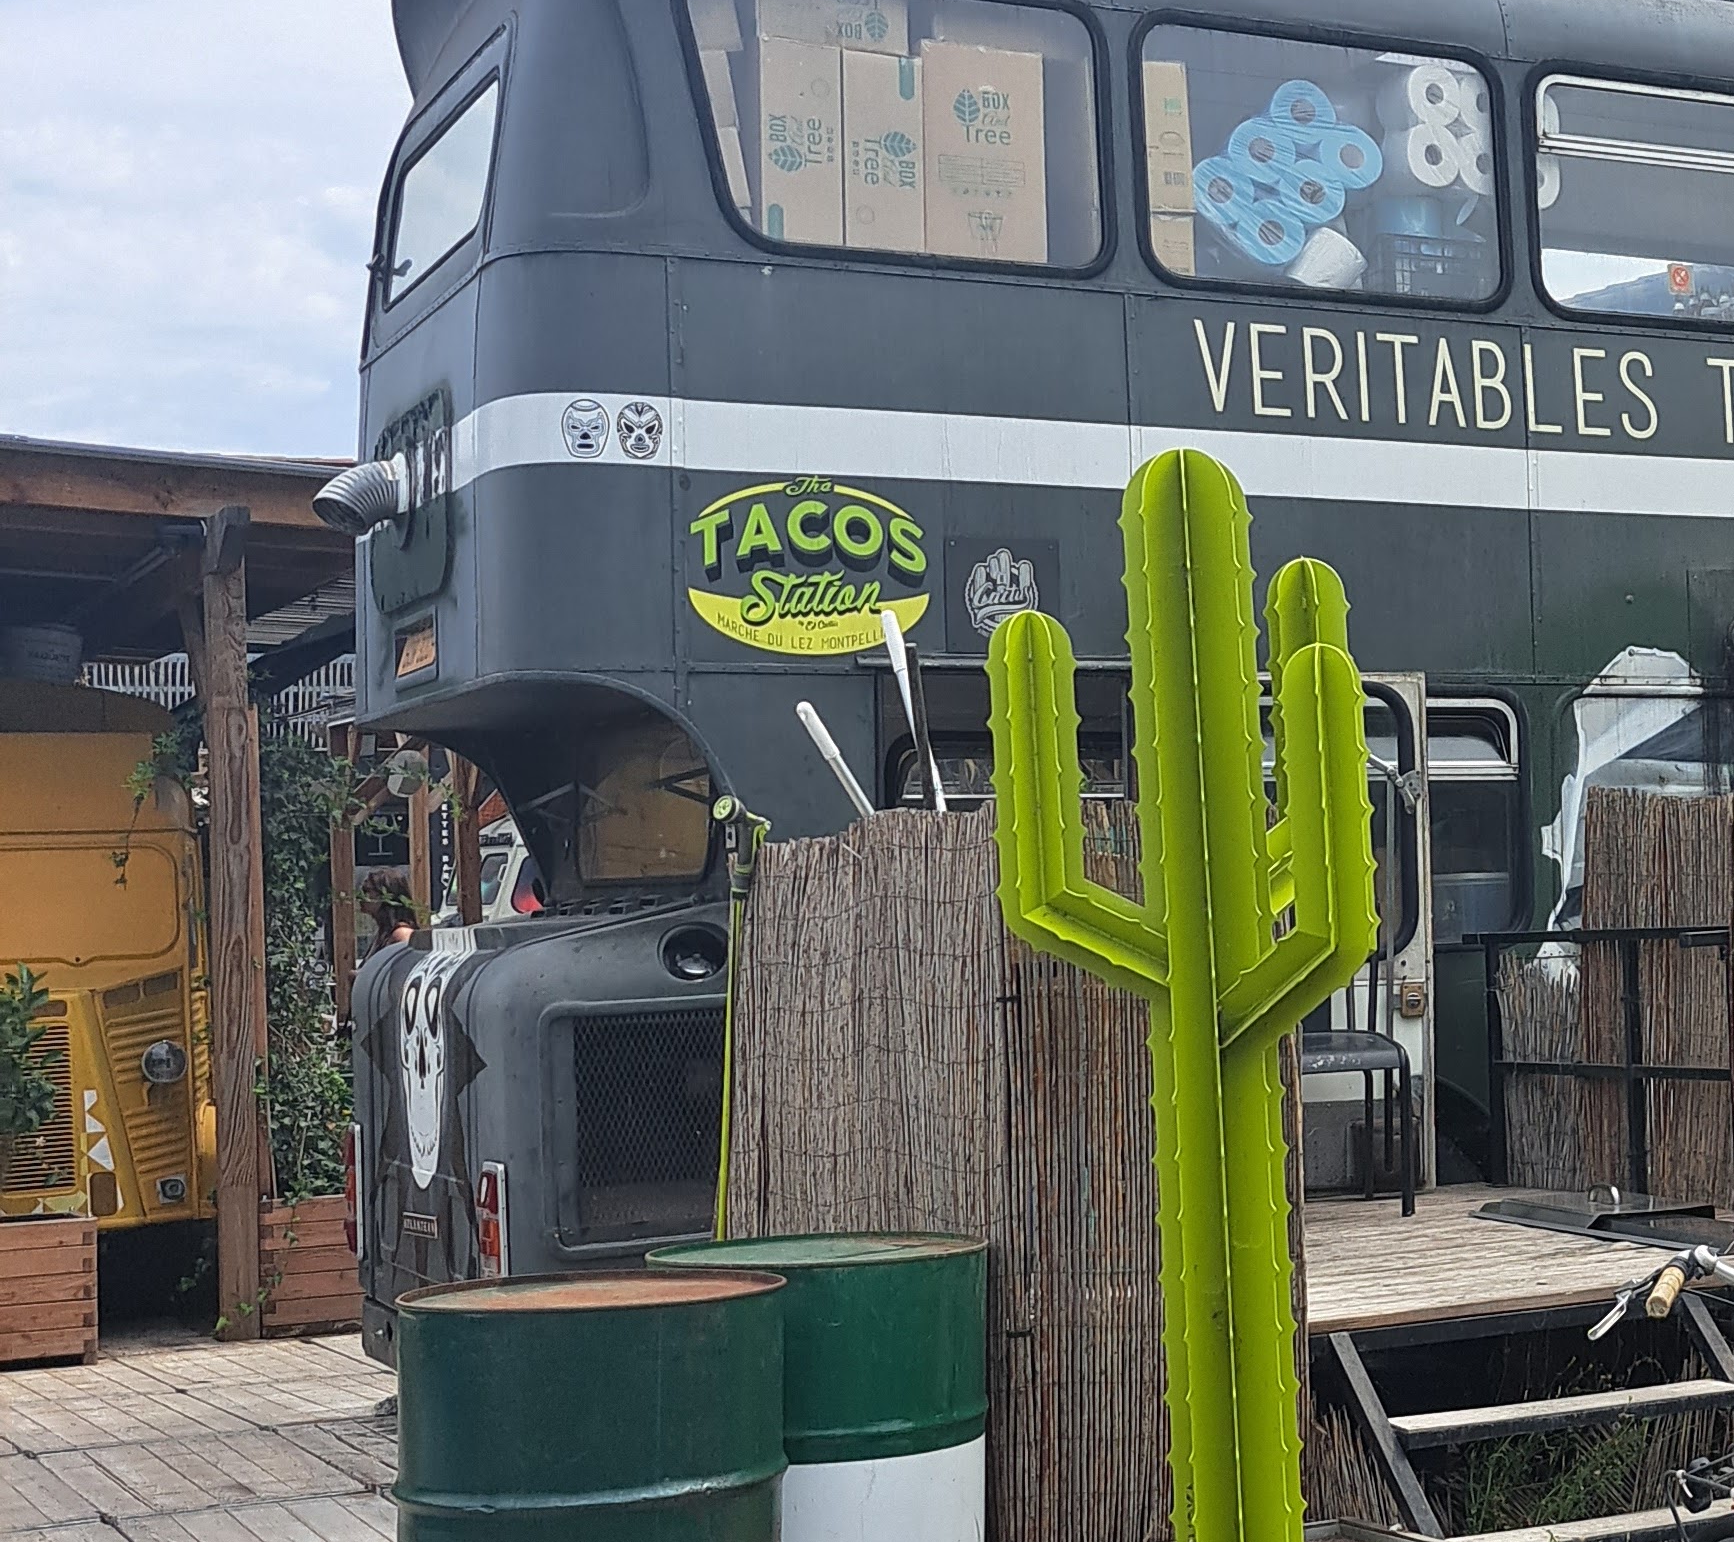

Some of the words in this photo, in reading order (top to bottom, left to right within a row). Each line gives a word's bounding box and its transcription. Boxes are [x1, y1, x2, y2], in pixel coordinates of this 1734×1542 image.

[768, 114, 787, 143] BOX
[803, 117, 823, 167] Tree
[964, 124, 1012, 146] Tree
[864, 137, 882, 186] Tree
[899, 161, 916, 188] BOX
[1192, 318, 1659, 441] VERITABLES
[784, 475, 834, 497] The
[689, 499, 930, 581] TACOS
[740, 569, 882, 625] Station
[716, 611, 761, 644] MARCHE
[767, 632, 783, 647] DU
[791, 637, 813, 650] LEZ
